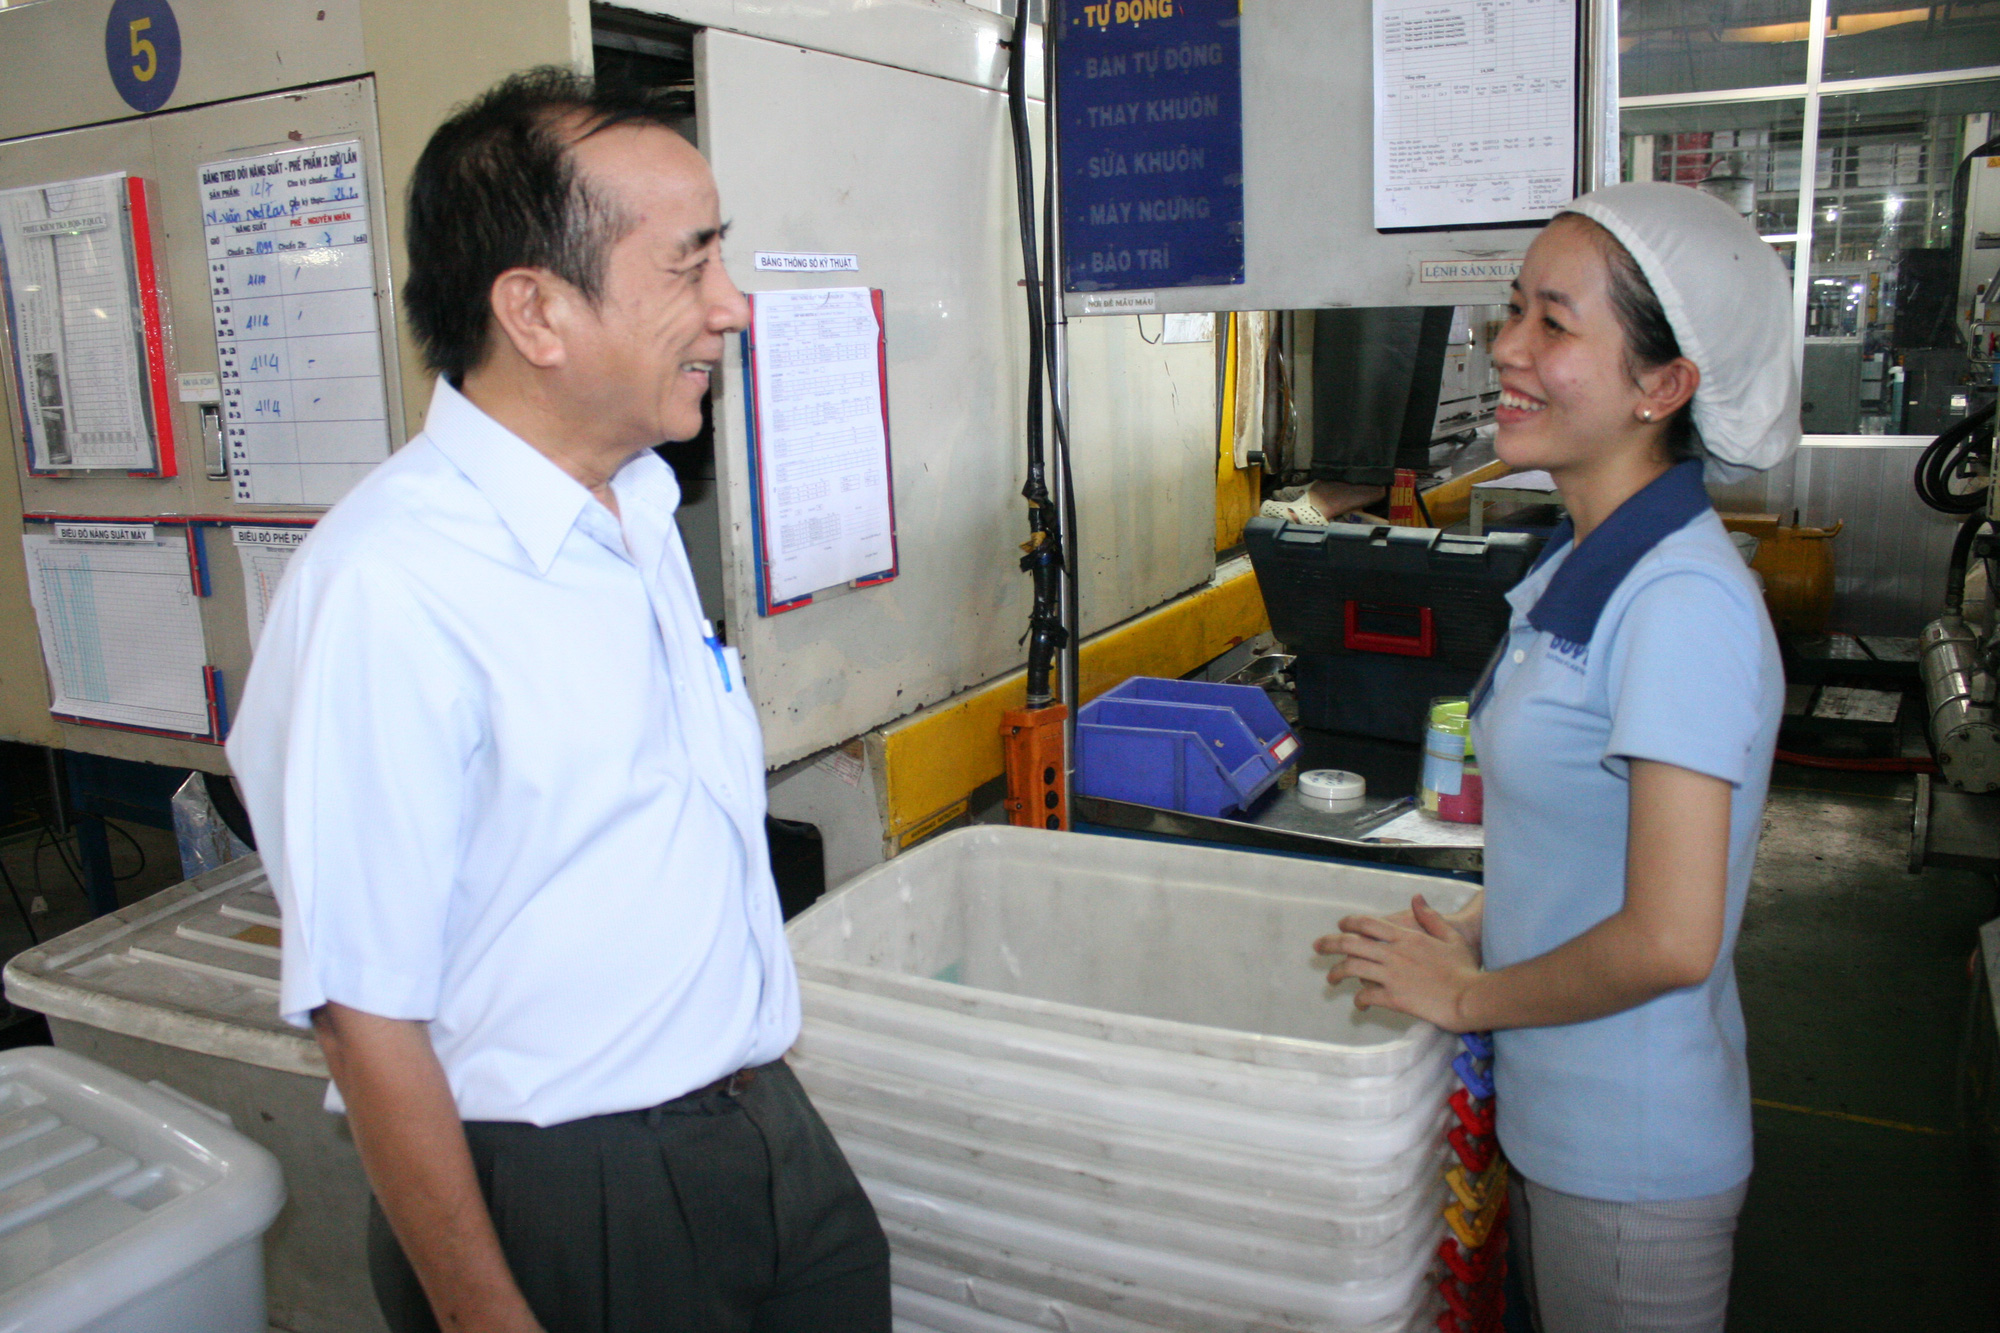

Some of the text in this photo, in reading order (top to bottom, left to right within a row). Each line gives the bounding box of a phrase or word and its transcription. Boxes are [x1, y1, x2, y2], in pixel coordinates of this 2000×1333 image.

[130, 18, 157, 82] 5
[1164, 41, 1223, 75] ĐỘNG
[1087, 92, 1219, 128] THAY KHUÔN
[220, 168, 236, 182] THEO
[323, 155, 328, 168] 2
[1088, 144, 1205, 179] SỬA KHUÔN
[1090, 198, 1132, 226] MÁY
[761, 256, 783, 267] BẢNG
[784, 257, 808, 268] THÔNG
[809, 257, 819, 268] SỐ
[1091, 242, 1169, 273] BẢO TRÌ
[1425, 263, 1458, 280] LỆNH
[1461, 263, 1486, 277] SẢN
[61, 528, 77, 538] BIỂU
[78, 528, 88, 539] ĐỒ
[110, 529, 129, 540] SUẤT
[130, 530, 147, 540] MÁY
[238, 530, 257, 542] BIỂU
[259, 531, 271, 542] ĐỒ
[273, 532, 290, 543] PHẾ
